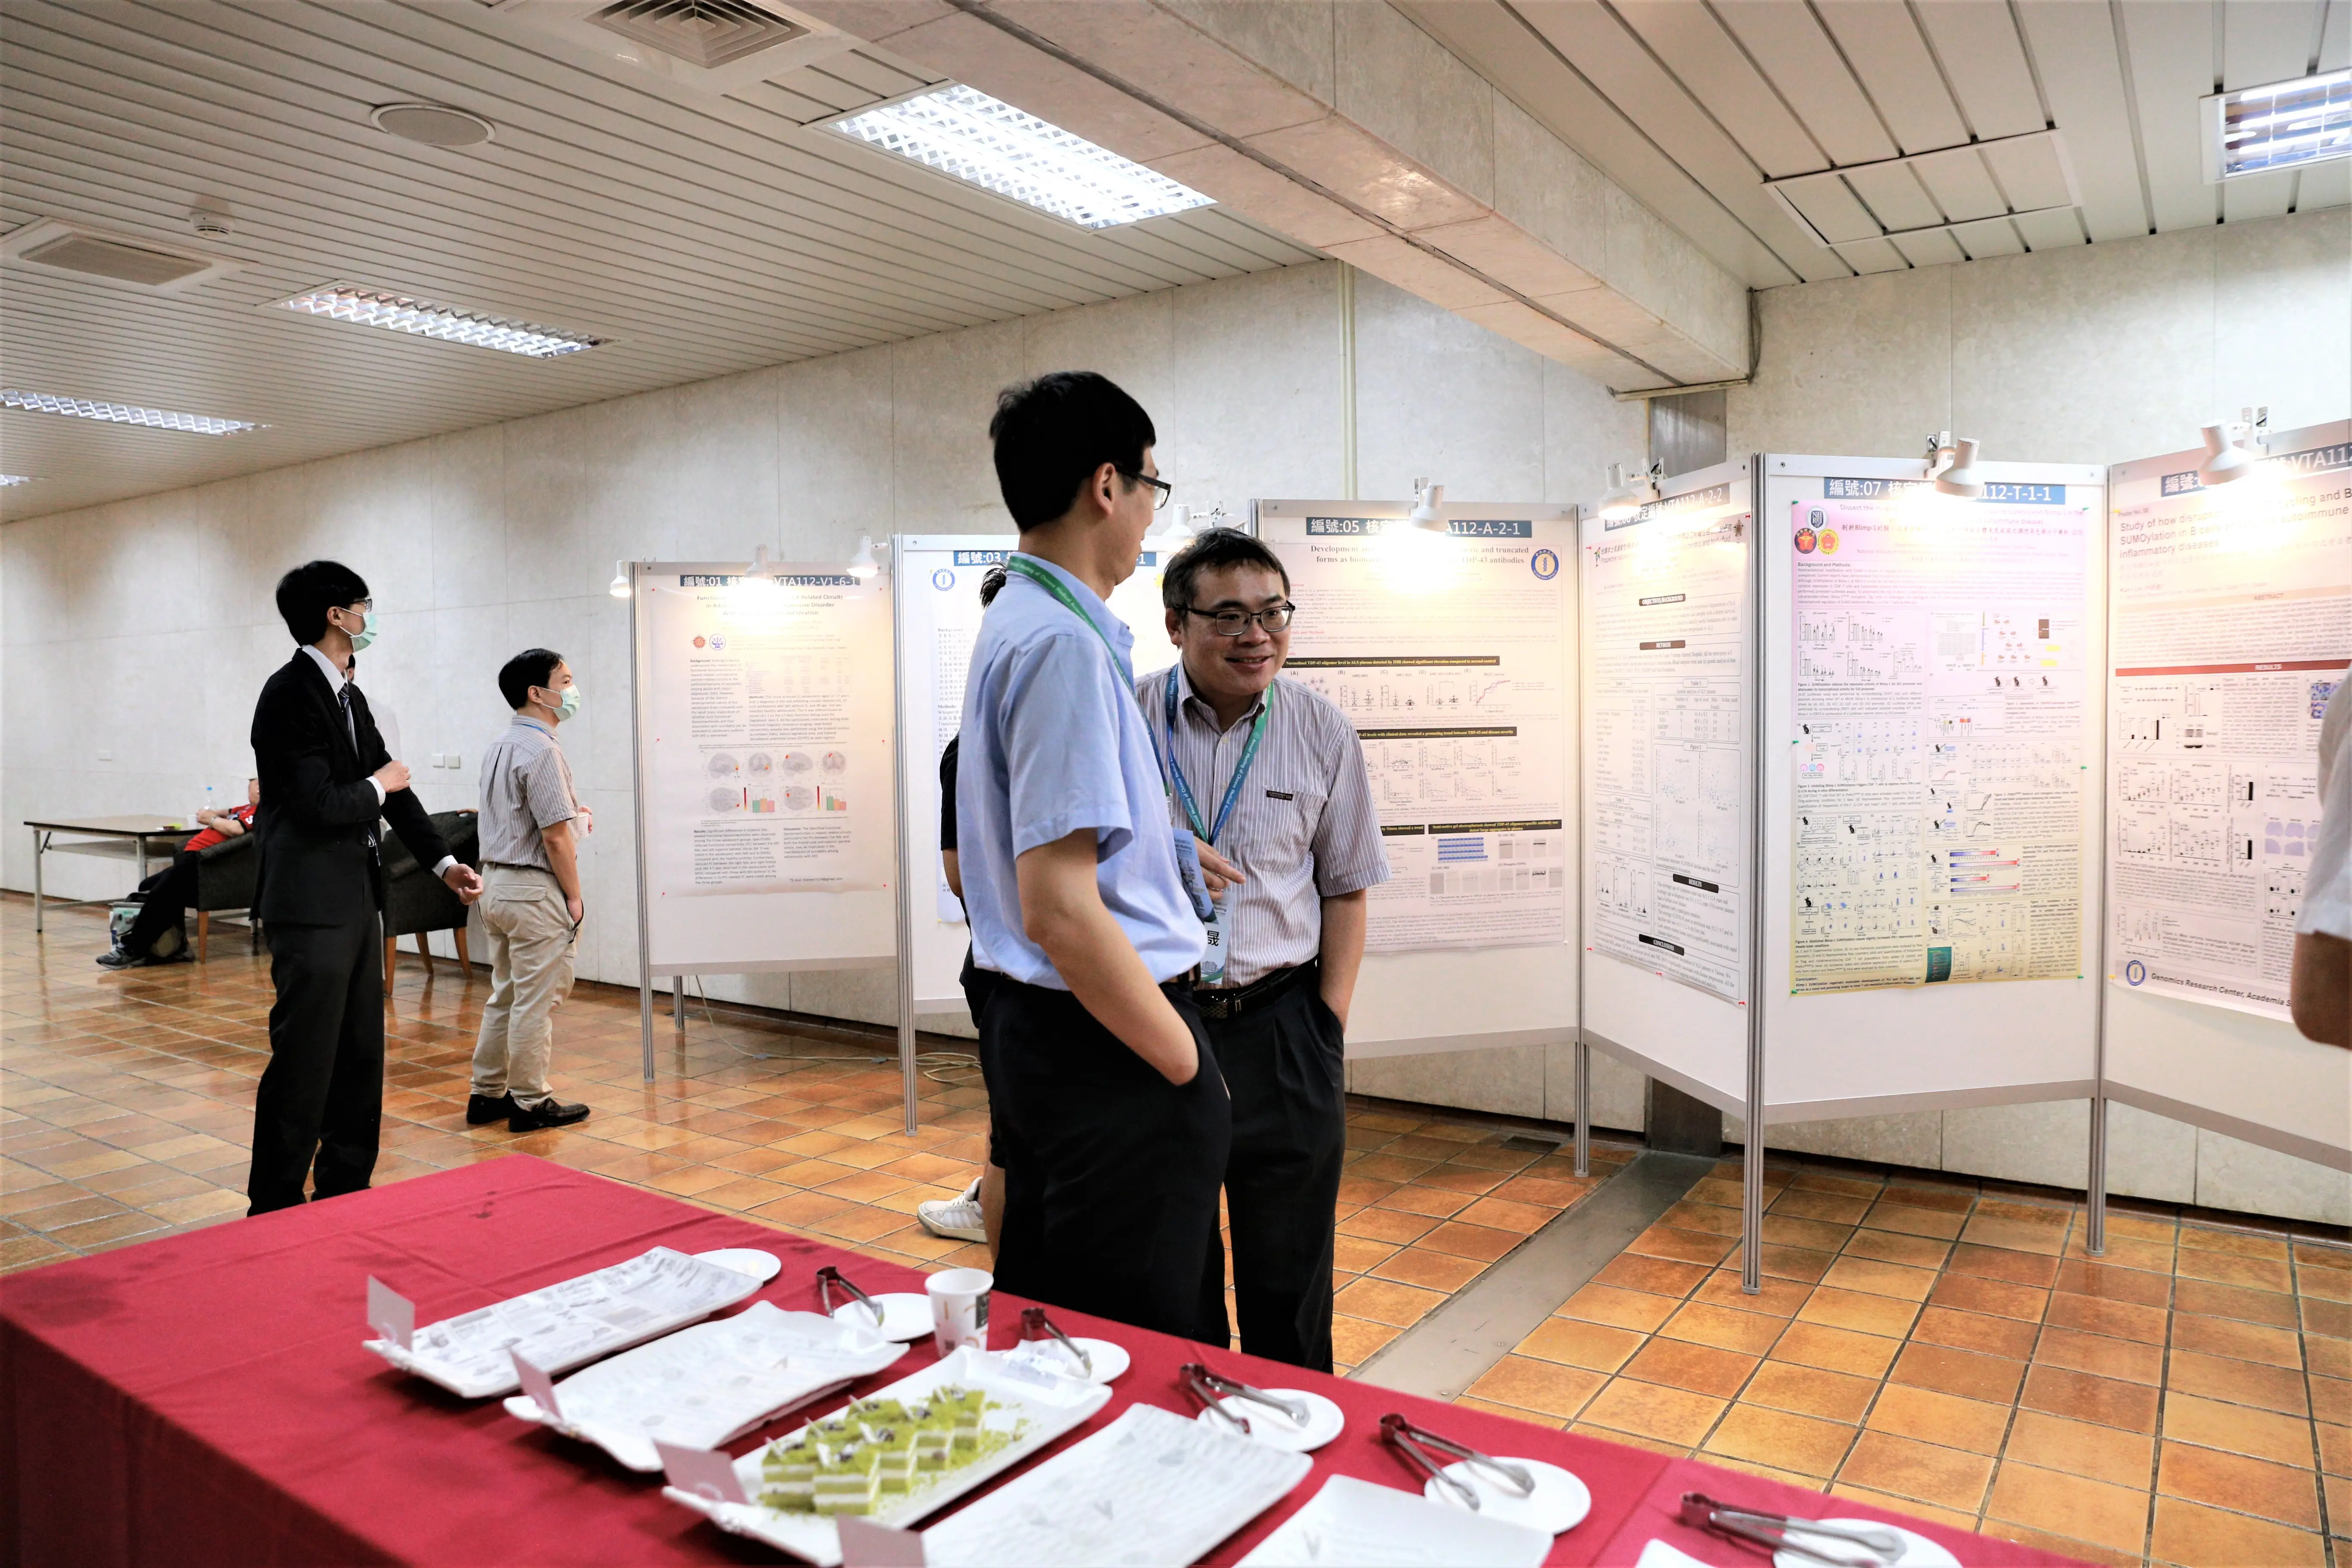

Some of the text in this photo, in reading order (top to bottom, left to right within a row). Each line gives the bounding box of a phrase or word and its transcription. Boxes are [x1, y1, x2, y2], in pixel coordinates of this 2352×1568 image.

[1829, 479, 1881, 496] 編號:07
[2165, 472, 2205, 493] 編號:
[2320, 490, 2340, 502] and
[2281, 506, 2349, 523] autoimmune
[1311, 519, 1360, 533] 編號:05
[2121, 521, 2144, 531] Study
[2147, 518, 2156, 528] of
[2159, 516, 2176, 526] how
[2121, 530, 2176, 545] SUMOylation
[2179, 529, 2187, 537] in
[2190, 527, 2196, 536] B
[1311, 545, 1358, 554] Development
[2120, 539, 2219, 558] inflammatory diseases
[958, 552, 1001, 564] 編號:03
[684, 576, 722, 587] 編號:01
[1642, 595, 1684, 605] OBJECTIVES/BACKGROUND
[1688, 879, 1702, 887] RESULTS
[1207, 930, 1220, 946] 晟
[1653, 939, 1674, 951] CONCLUSIONS
[2151, 973, 2184, 985] Genomics
[2185, 980, 2217, 992] Research
[2219, 986, 2245, 998] Center,
[2247, 992, 2285, 1005] Academia
